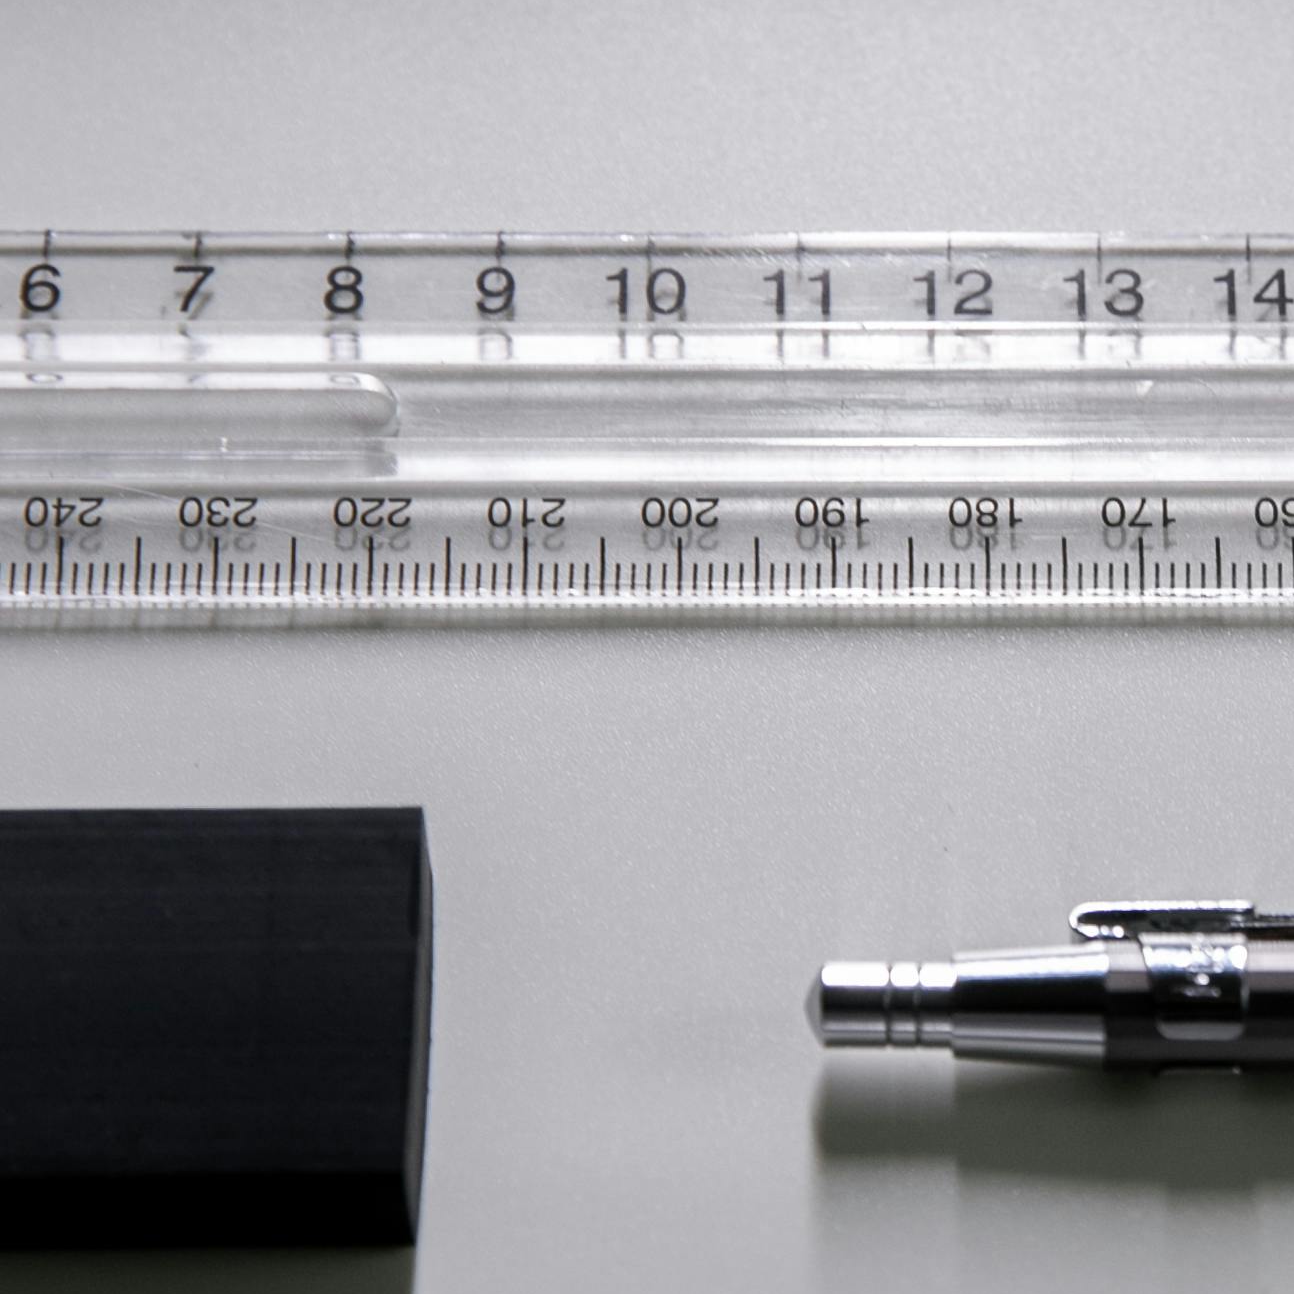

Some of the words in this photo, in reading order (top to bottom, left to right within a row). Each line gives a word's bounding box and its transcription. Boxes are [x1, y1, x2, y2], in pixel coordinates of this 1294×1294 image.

[22, 263, 60, 312] 6
[173, 264, 214, 313] 7
[325, 266, 364, 314] 8
[475, 267, 516, 315] 9
[606, 268, 686, 315] 10
[764, 269, 832, 316] 11
[914, 269, 994, 316] 12
[1065, 269, 1145, 317] 13
[1213, 269, 1294, 317] 14
[25, 497, 103, 528] 240
[179, 497, 257, 528] 230
[333, 497, 411, 528] 220
[487, 497, 566, 528] 210
[641, 497, 719, 528] 200
[795, 497, 870, 528] 190
[948, 497, 1022, 528] 180
[1101, 497, 1175, 528] 170
